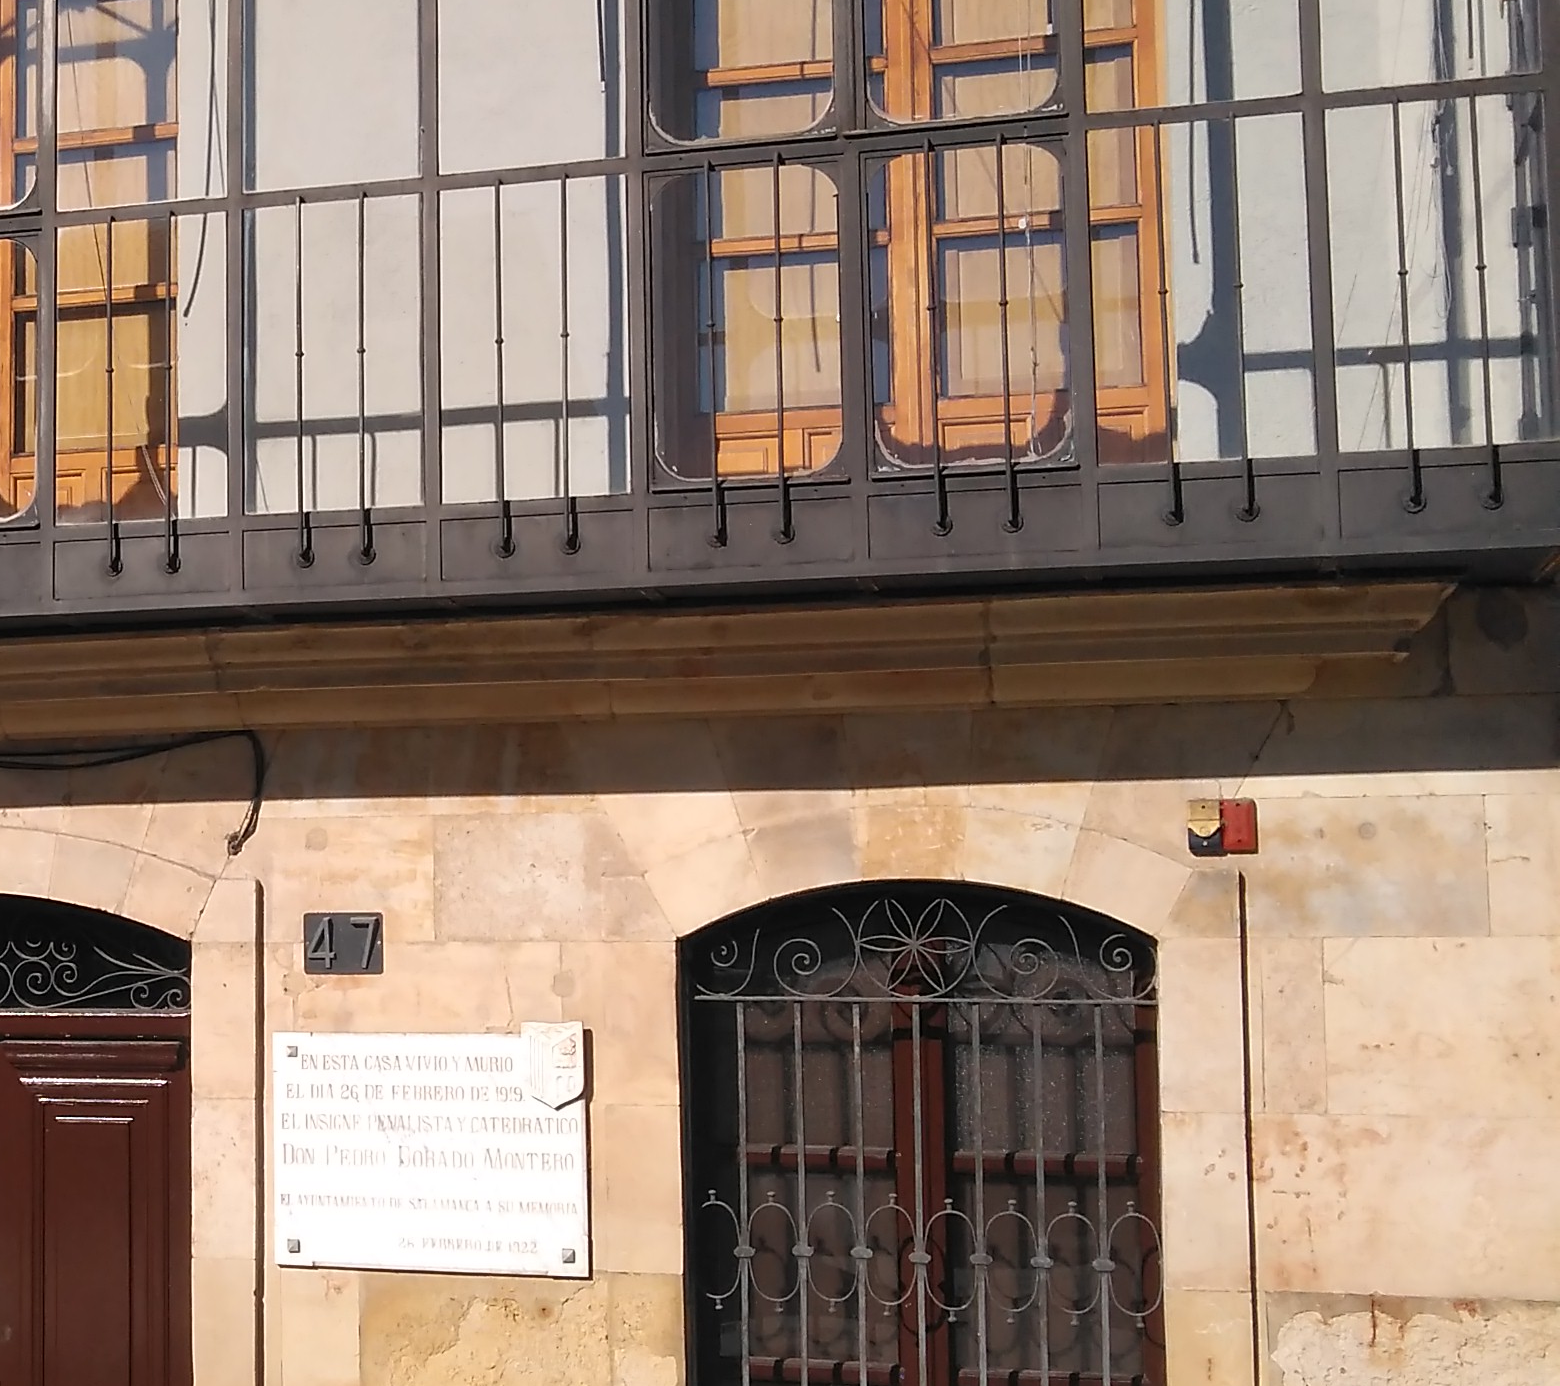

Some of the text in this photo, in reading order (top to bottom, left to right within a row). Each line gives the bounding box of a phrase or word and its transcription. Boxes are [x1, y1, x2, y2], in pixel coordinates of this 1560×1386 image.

[308, 916, 380, 968] 47
[301, 1053, 318, 1070] EN
[323, 1054, 359, 1071] ESTA
[364, 1055, 402, 1072] CASA
[452, 1056, 461, 1072] Y
[465, 1056, 514, 1073] MURIO
[286, 1083, 304, 1099] EL
[310, 1083, 334, 1099] DIA
[340, 1084, 359, 1102] 26
[365, 1084, 384, 1100] DE
[391, 1085, 465, 1101] FEBRERO
[471, 1086, 489, 1102] DE
[281, 1113, 300, 1130] EL
[305, 1113, 362, 1131] INSIGNE
[457, 1116, 466, 1132] Y
[471, 1117, 579, 1135] CATEDRATICO
[498, 1200, 514, 1213] SU
